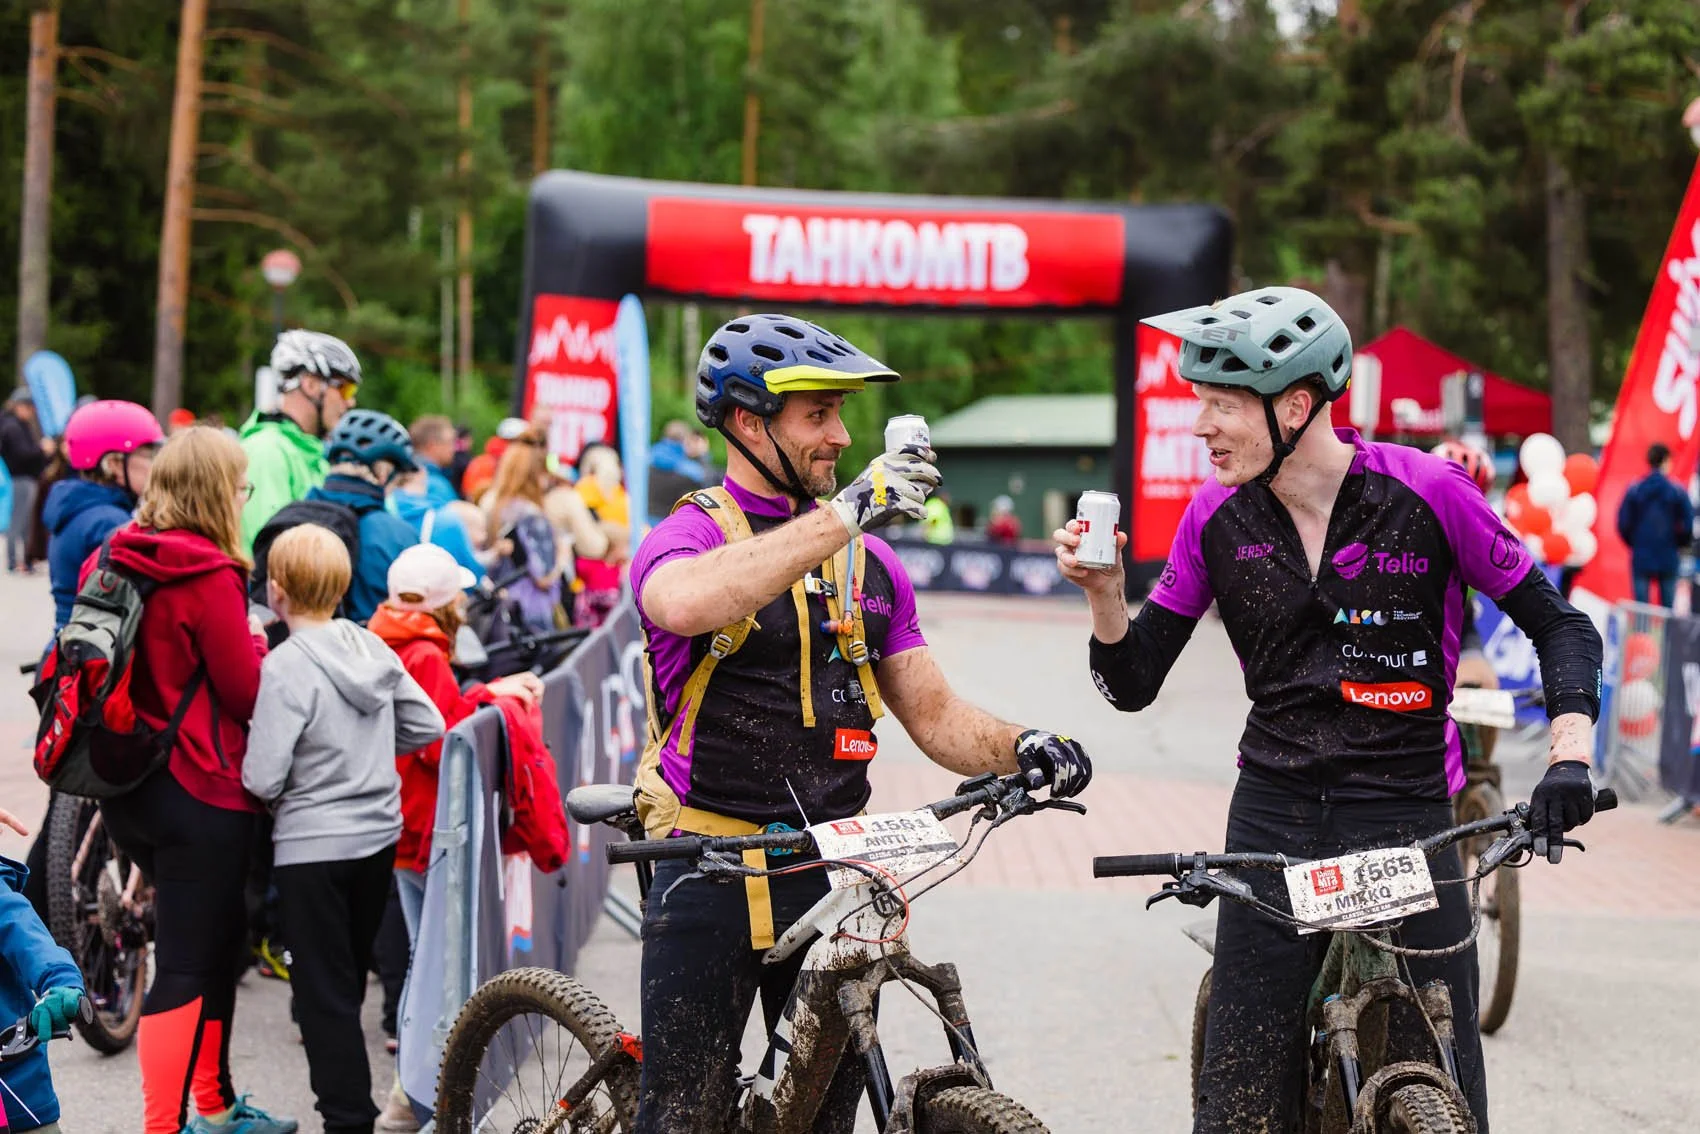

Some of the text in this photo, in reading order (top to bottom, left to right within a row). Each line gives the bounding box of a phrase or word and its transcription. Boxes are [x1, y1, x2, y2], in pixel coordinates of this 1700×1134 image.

[742, 214, 1030, 291] TAHKOMTB
[1373, 552, 1429, 574] Telia
[1349, 687, 1426, 705] Lenovo
[865, 834, 909, 848] ANTTI
[1353, 856, 1414, 886] 1565
